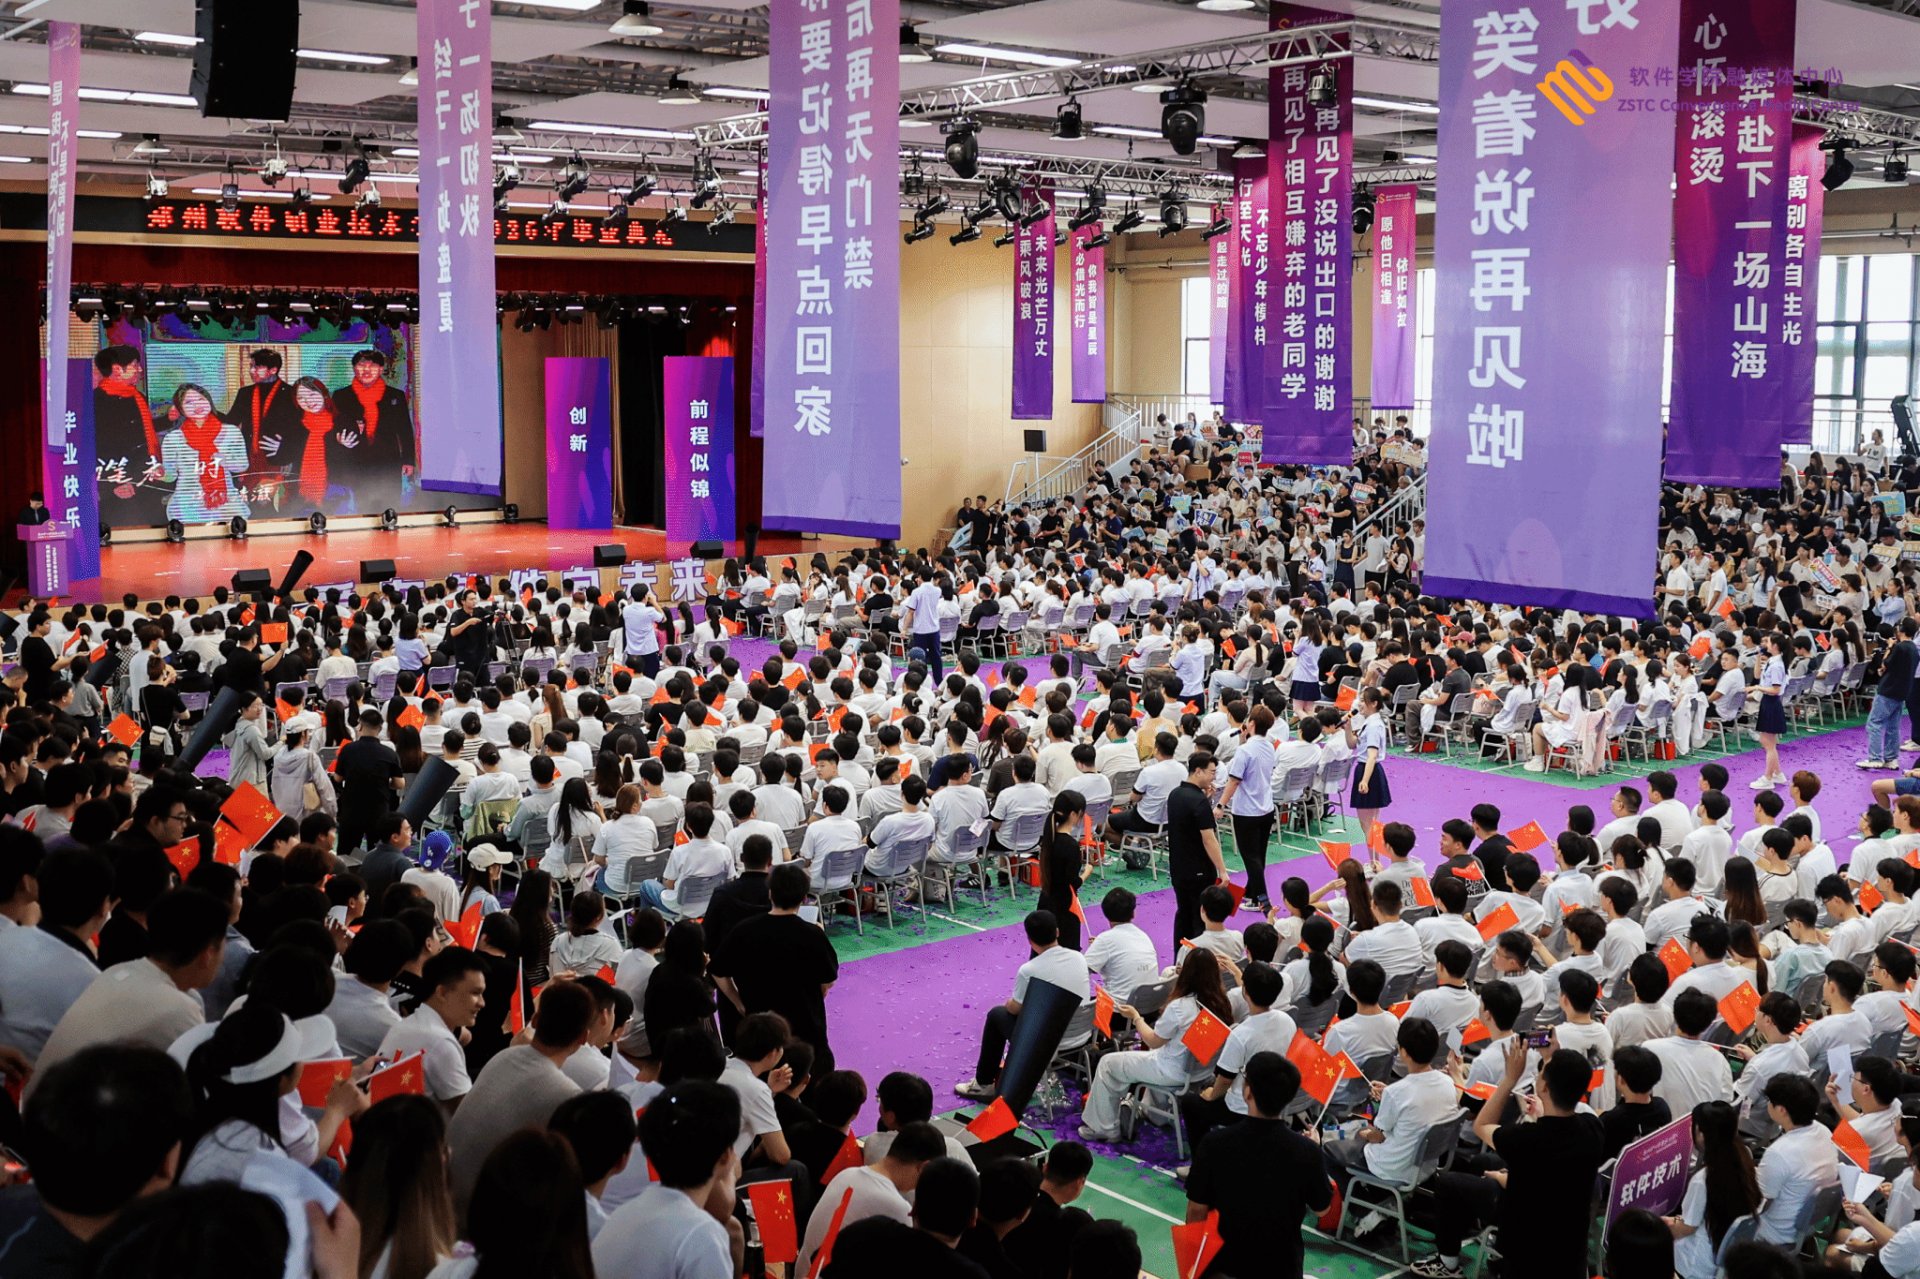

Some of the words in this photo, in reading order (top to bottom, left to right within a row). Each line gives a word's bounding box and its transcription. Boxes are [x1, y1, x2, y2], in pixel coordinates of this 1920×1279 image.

[1689, 12, 1728, 186] 心怀滚烫
[1074, 235, 1086, 329] 不必借光而行
[1280, 65, 1307, 400] 再见了相互嫌弃的老同学
[1313, 104, 1340, 412] 再见了没说出口的谢谢
[1731, 71, 1776, 380] 奔赴下一场山海
[1782, 174, 1809, 346] 离别各自生光
[1034, 233, 1048, 358] 未来光芒万丈
[1087, 263, 1098, 357] 你我皆是星辰
[60, 410, 81, 529] 毕业快乐
[568, 406, 588, 453] 创新
[689, 399, 711, 499] 前程似锦
[1619, 1152, 1683, 1208] 软件技术
